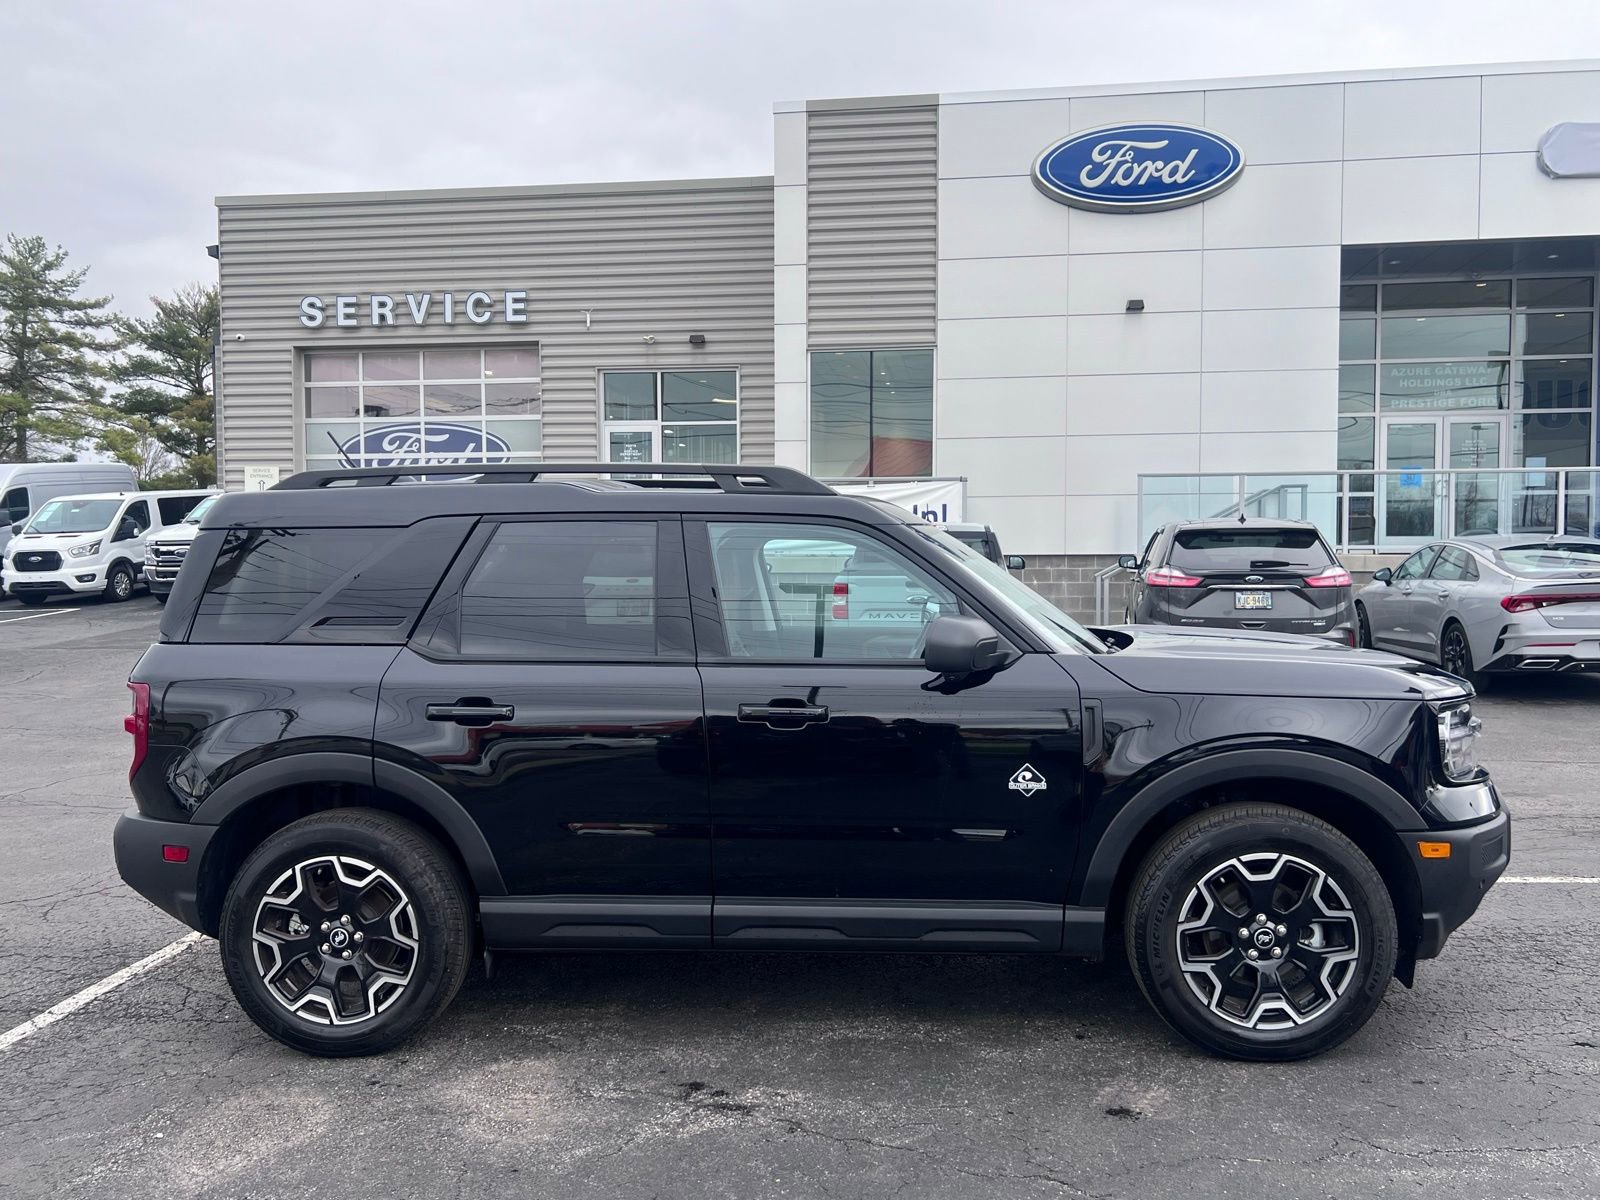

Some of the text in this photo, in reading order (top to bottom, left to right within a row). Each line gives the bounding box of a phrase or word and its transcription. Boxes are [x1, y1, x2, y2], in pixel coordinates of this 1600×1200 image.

[1080, 140, 1199, 187] Ford
[300, 291, 528, 328] SERVICE
[1391, 367, 1431, 377] AZURE
[1400, 377, 1488, 388] HOLDINGS LLC
[1391, 397, 1498, 409] PRESTIGE FORD
[1152, 892, 1171, 959] MICHELIN
